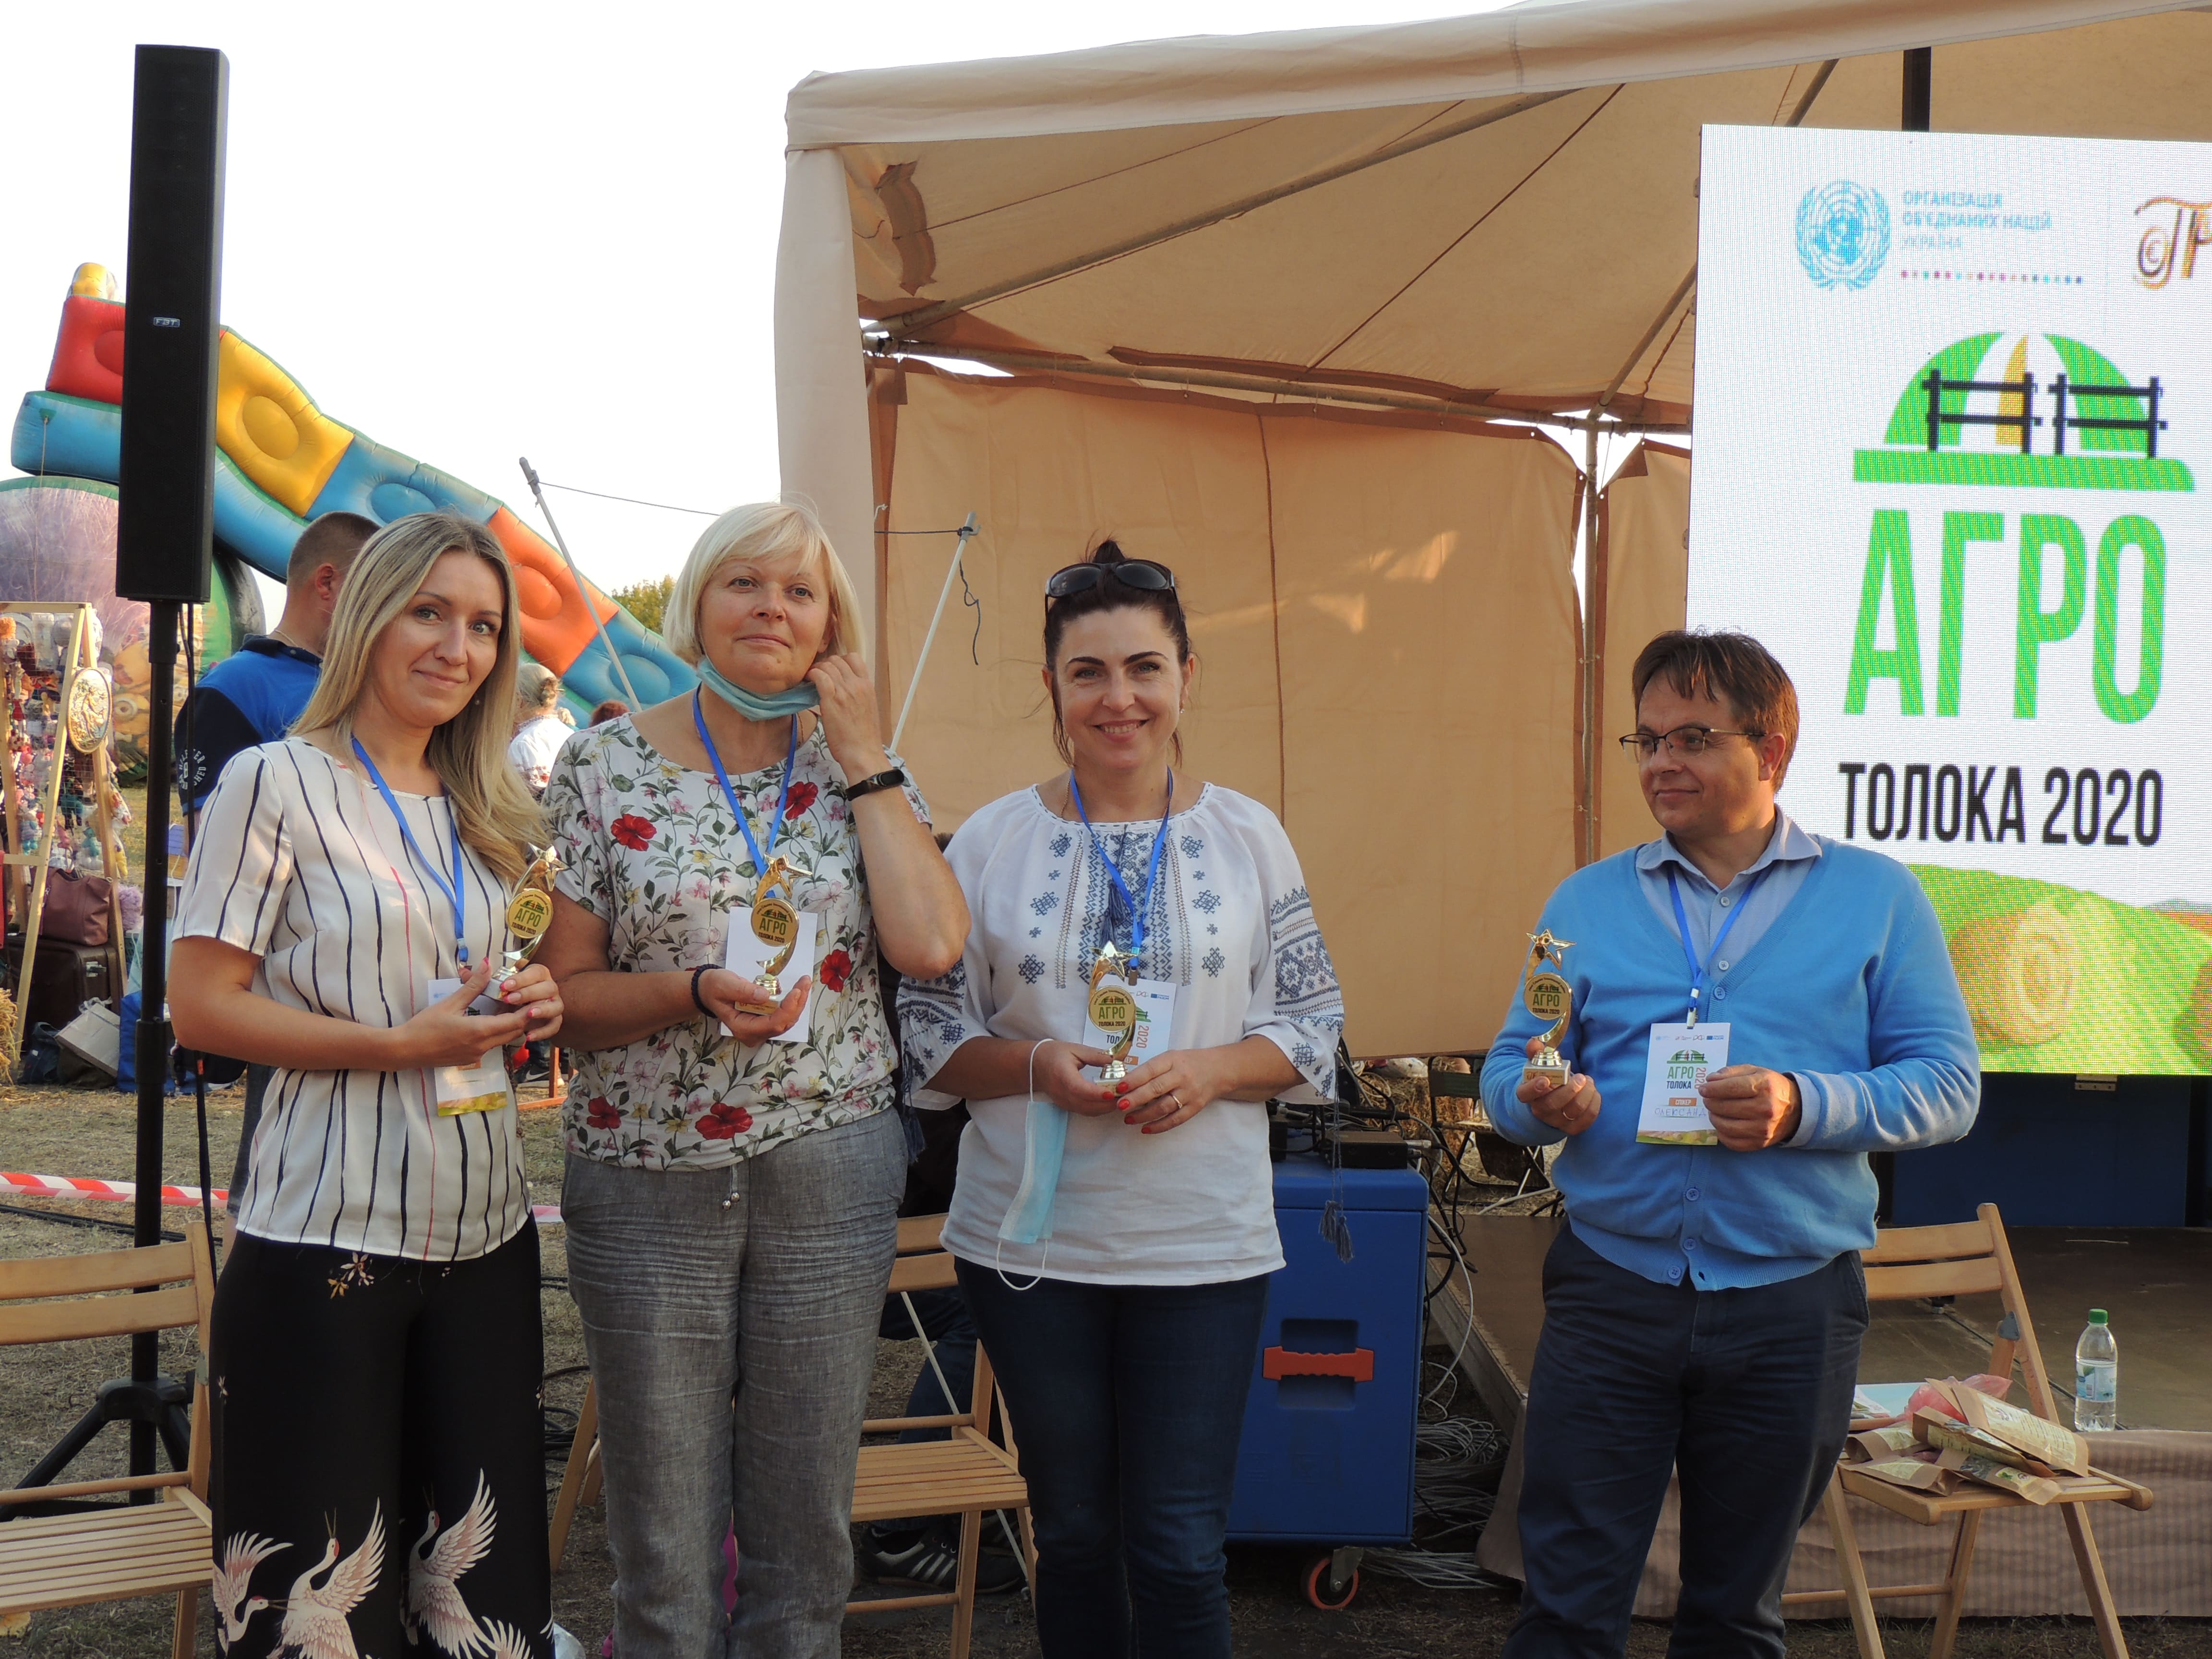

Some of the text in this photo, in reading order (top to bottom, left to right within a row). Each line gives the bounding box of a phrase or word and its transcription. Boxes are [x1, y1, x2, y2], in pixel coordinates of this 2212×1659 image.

[1843, 509, 2165, 723] АГРО
[1838, 762, 2164, 846] ТОЛОКА 2020
[515, 908, 541, 927] АГРО
[759, 918, 786, 936] АГРО
[1533, 993, 1559, 1007] АГРО
[1099, 1006, 1125, 1019] АГРО
[1106, 1034, 1122, 1044] ТОЛ
[1136, 1025, 1149, 1048] 2020
[1667, 1066, 1694, 1079] АГРО
[1666, 1081, 1692, 1089] ТОЛОКА
[1654, 1107, 1707, 1117] ОЛЕКСАНД
